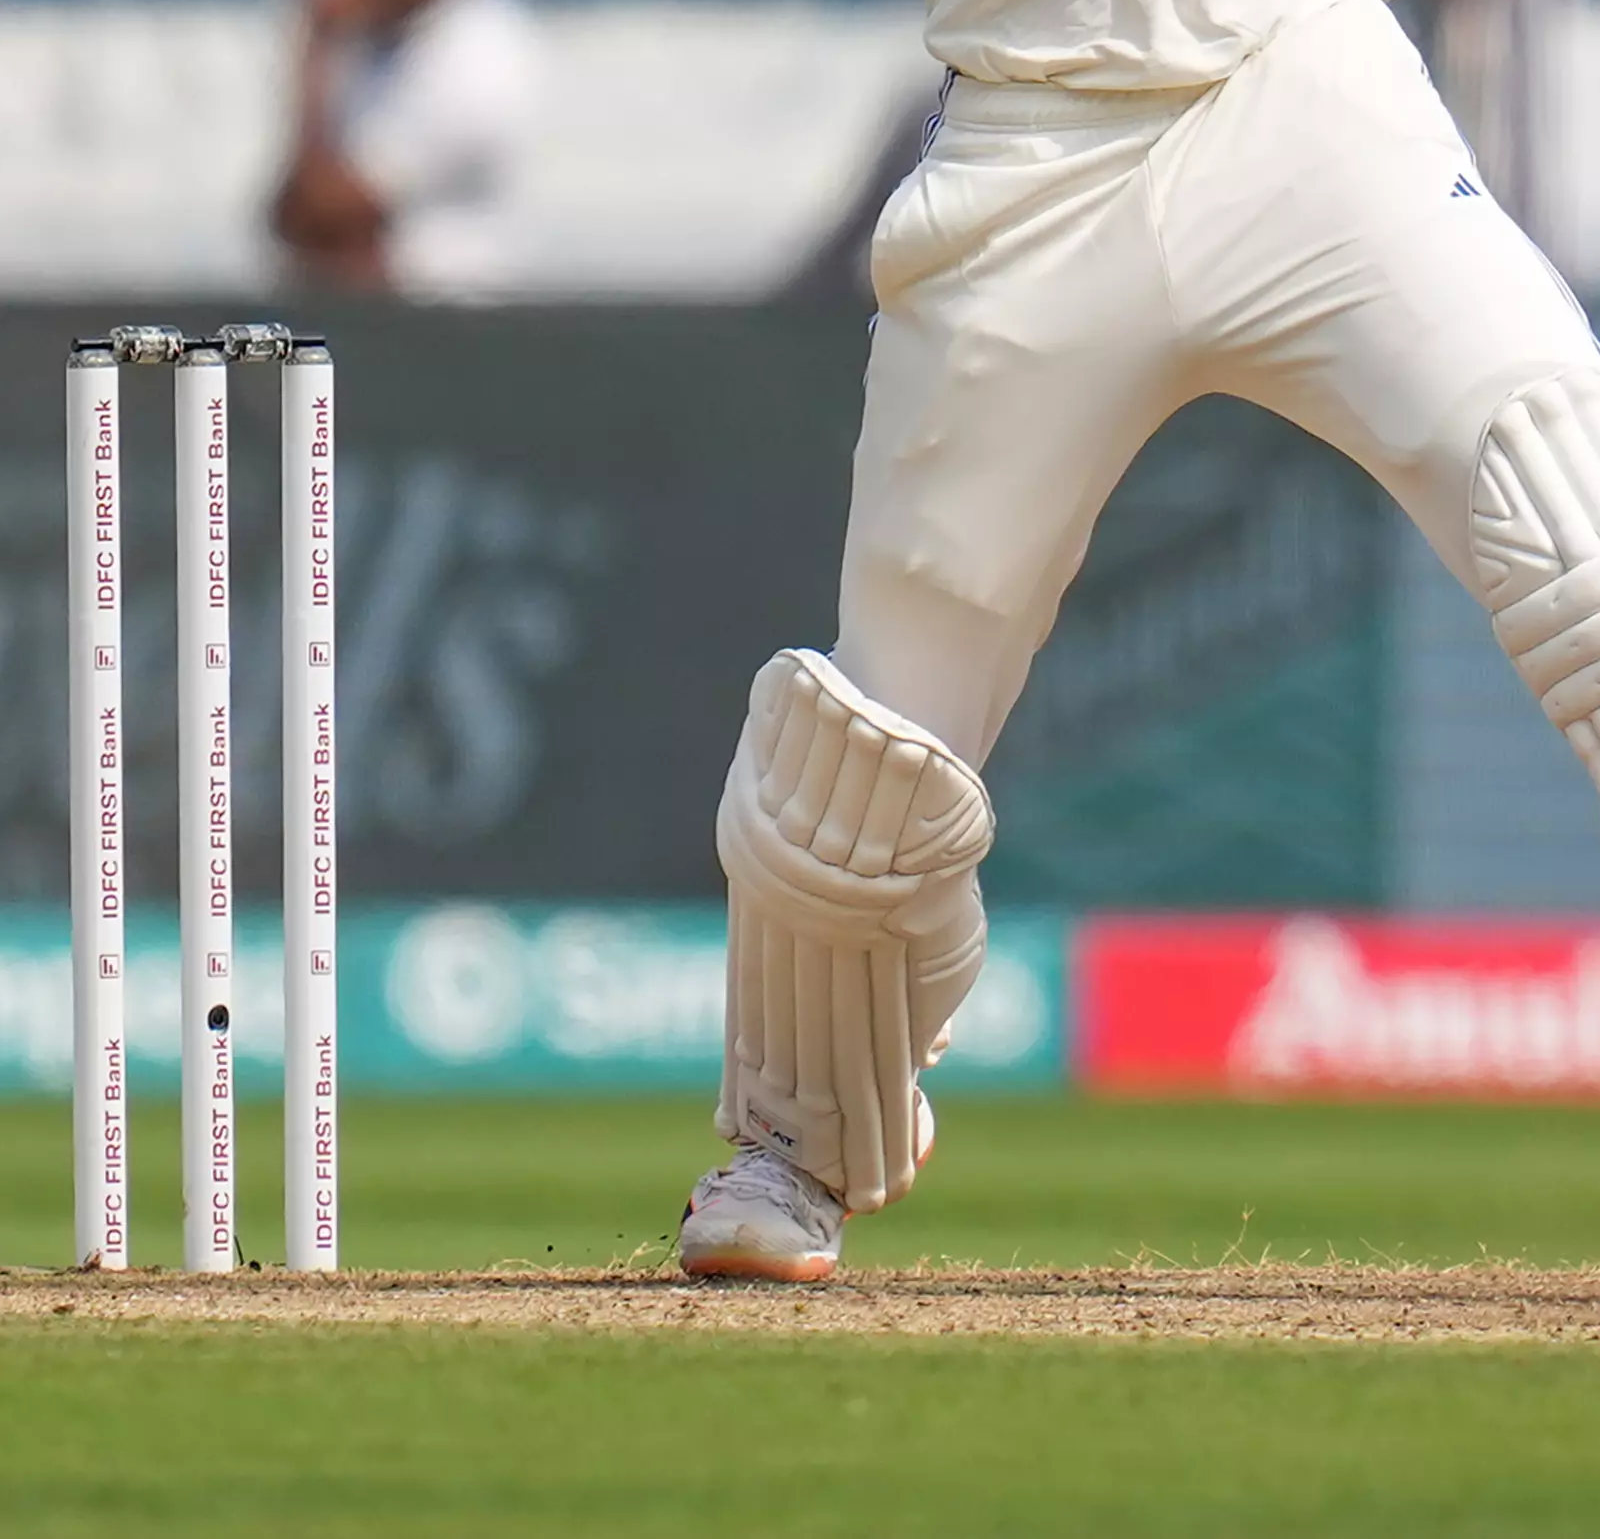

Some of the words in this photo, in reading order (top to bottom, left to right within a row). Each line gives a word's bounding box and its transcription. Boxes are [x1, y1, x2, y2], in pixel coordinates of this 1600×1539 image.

[95, 398, 114, 461] Bank
[207, 397, 225, 460] Bank
[312, 396, 329, 459] Bank
[95, 469, 114, 543] FIRST
[207, 468, 225, 542] FIRST
[312, 466, 329, 540] FIRST
[95, 550, 114, 610] IDFC
[207, 549, 225, 608] IDFC
[312, 547, 329, 607] IDFC
[100, 707, 118, 769] Bank
[210, 706, 227, 768] Bank
[313, 704, 330, 766] Bank
[100, 778, 118, 851] FIRST
[210, 777, 227, 850] FIRST
[313, 774, 330, 847] FIRST
[100, 858, 118, 919] IDFC
[210, 857, 227, 917] IDFC
[313, 854, 330, 915] IDFC
[104, 1038, 122, 1102] Bank
[212, 1036, 229, 1100] Bank
[315, 1034, 333, 1097] Bank
[104, 1110, 122, 1184] FIRST
[212, 1109, 229, 1183] FIRST
[315, 1106, 333, 1181] FIRST
[104, 1192, 122, 1254] IDFC
[212, 1191, 229, 1252] IDFC
[315, 1189, 333, 1249] IDFC
